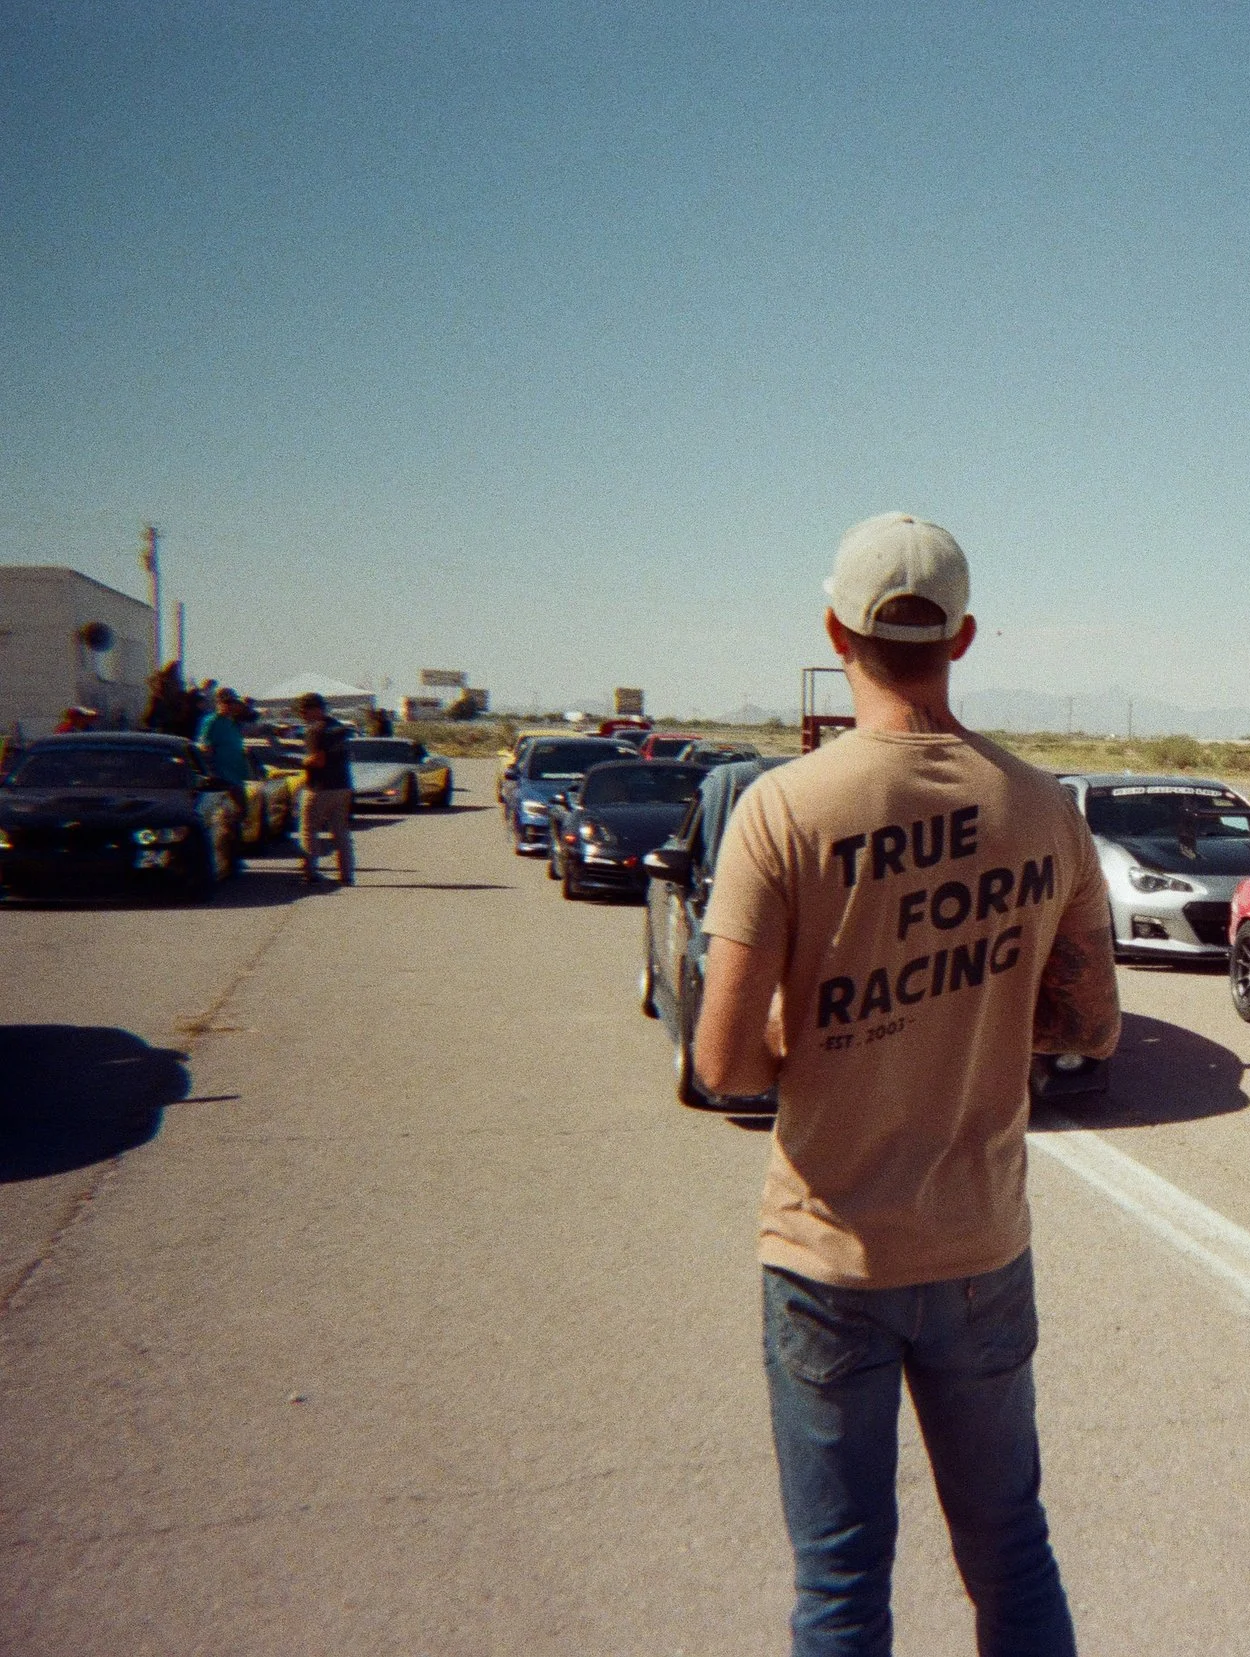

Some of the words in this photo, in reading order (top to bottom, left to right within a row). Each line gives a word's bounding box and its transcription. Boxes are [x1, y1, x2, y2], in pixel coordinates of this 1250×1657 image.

[831, 804, 979, 889] TRUE
[897, 854, 1055, 941] FORM
[816, 925, 1024, 1029] RACING
